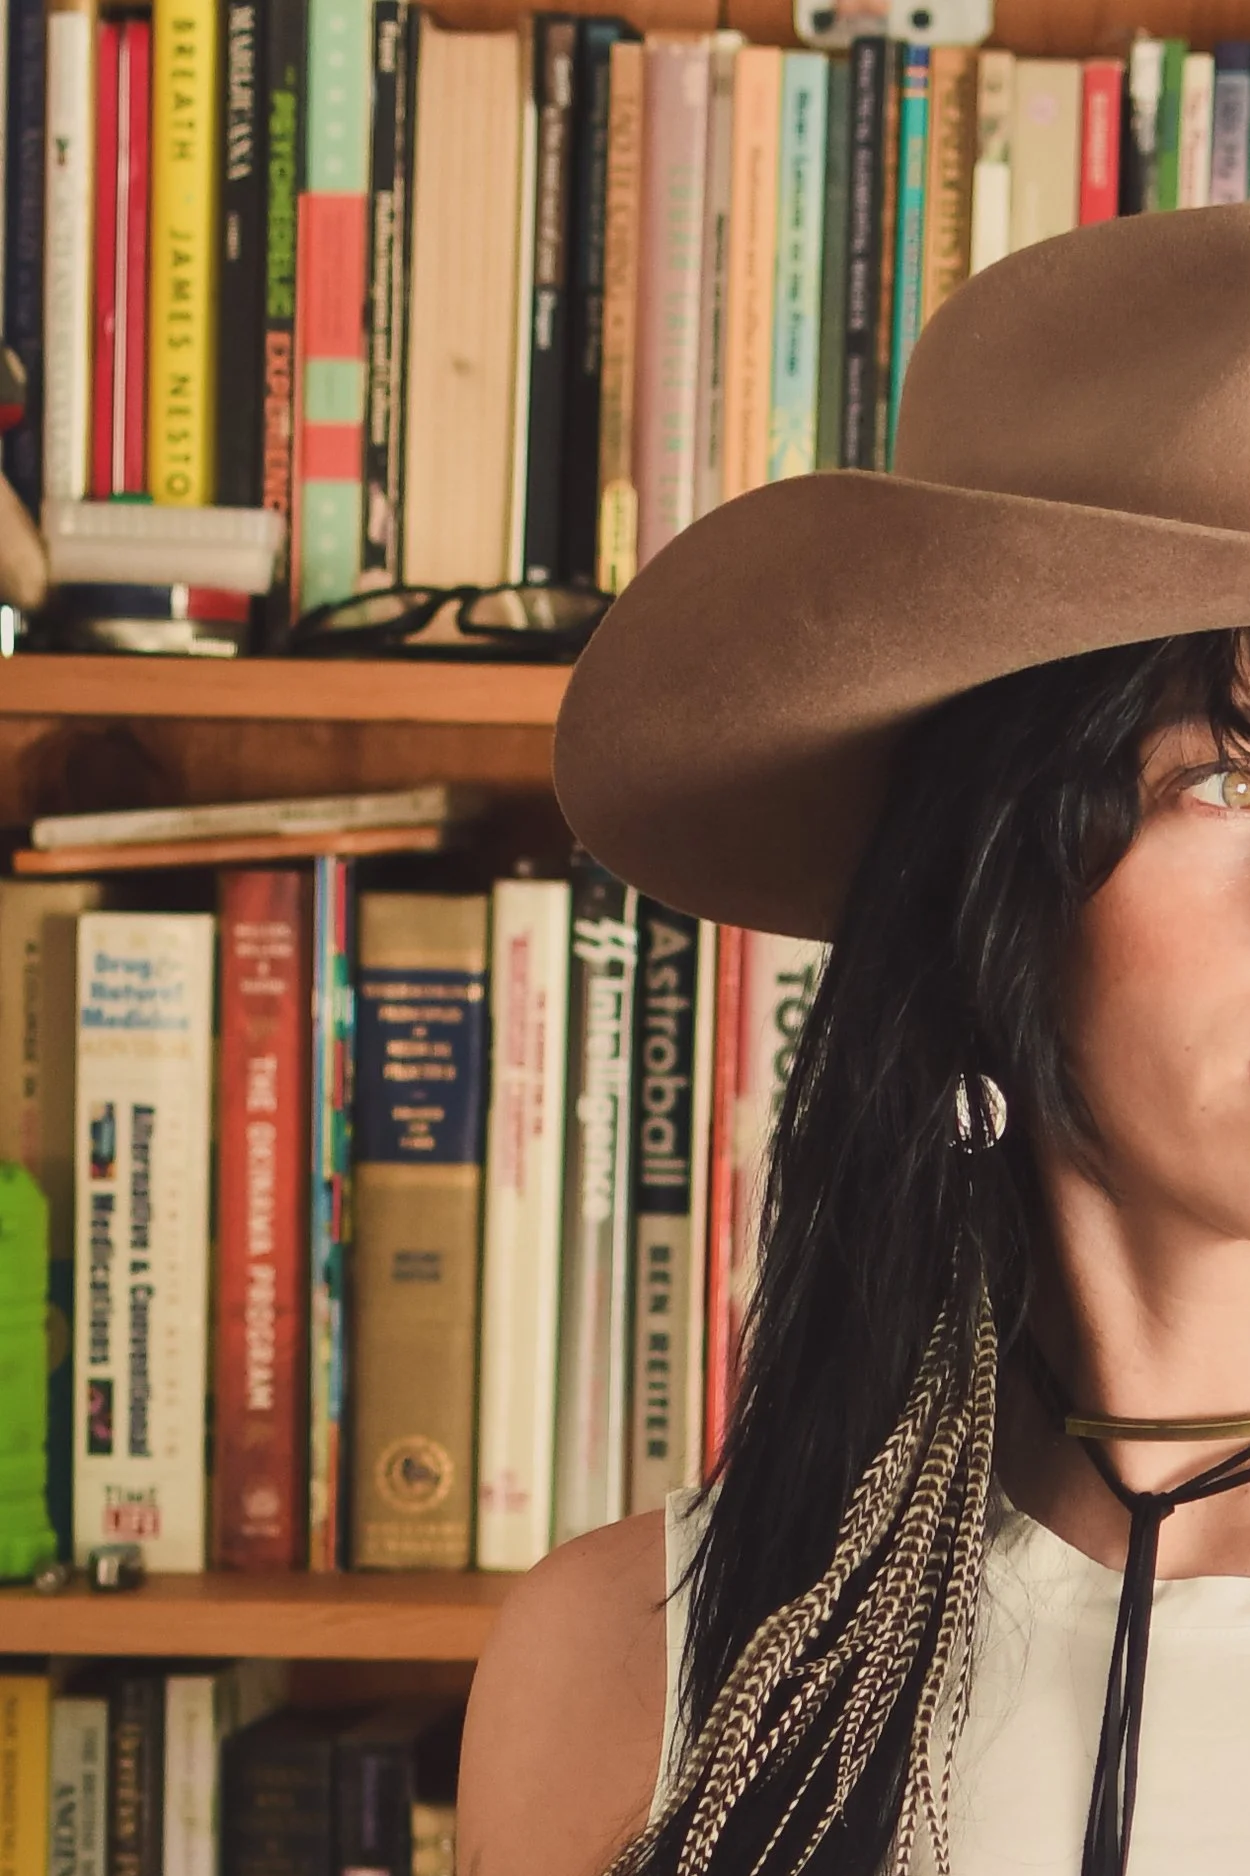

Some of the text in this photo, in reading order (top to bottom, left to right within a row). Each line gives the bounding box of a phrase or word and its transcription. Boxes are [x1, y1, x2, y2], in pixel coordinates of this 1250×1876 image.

[164, 17, 199, 500] BREATH JAMES NESTO
[129, 1103, 158, 1249] Alternative
[580, 976, 629, 1221] Intelligence
[641, 918, 692, 1459] Astroball BEN REITER
[89, 1193, 118, 1365] Medications
[245, 1056, 278, 1411] THE OKINAWA PROGRAM
[129, 1284, 157, 1458] Conventional
